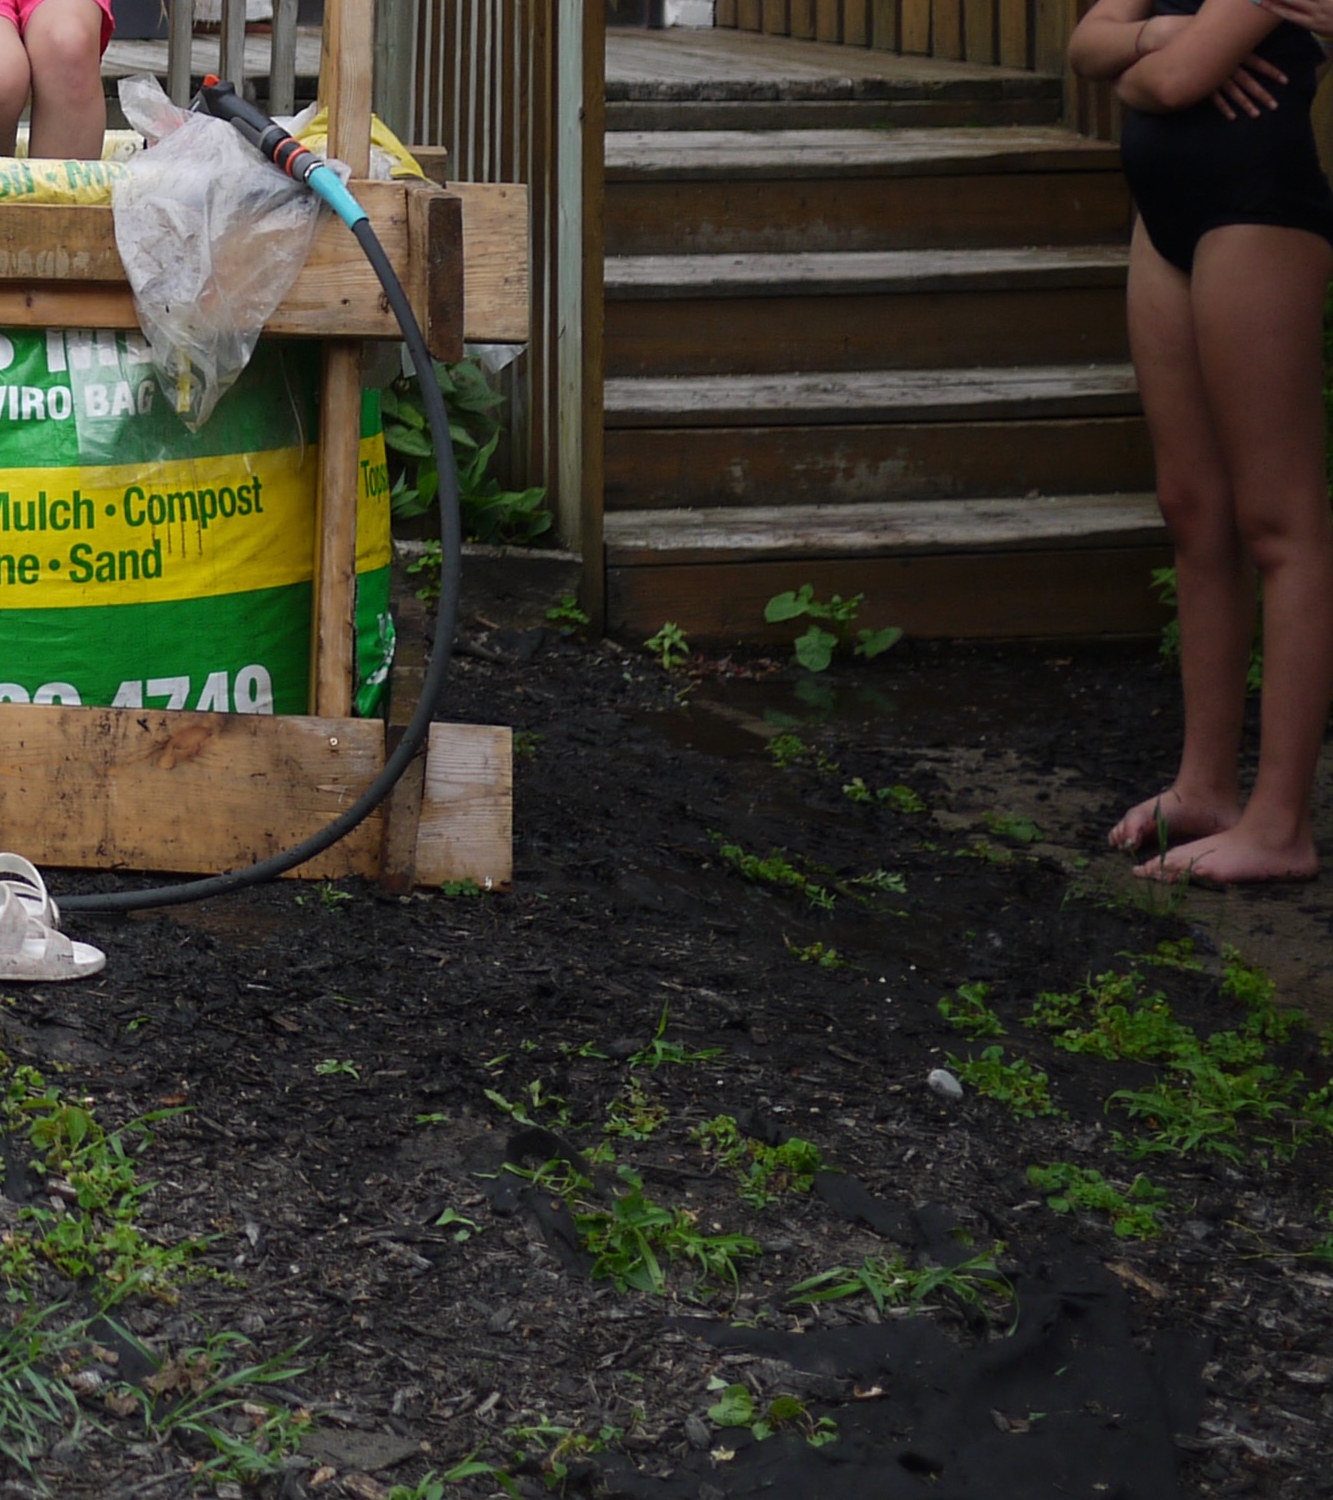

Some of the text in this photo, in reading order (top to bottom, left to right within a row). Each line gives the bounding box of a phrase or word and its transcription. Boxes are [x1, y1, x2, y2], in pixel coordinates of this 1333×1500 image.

[83, 379, 155, 418] BAG
[123, 475, 264, 529] Compost
[69, 539, 162, 584] Sand
